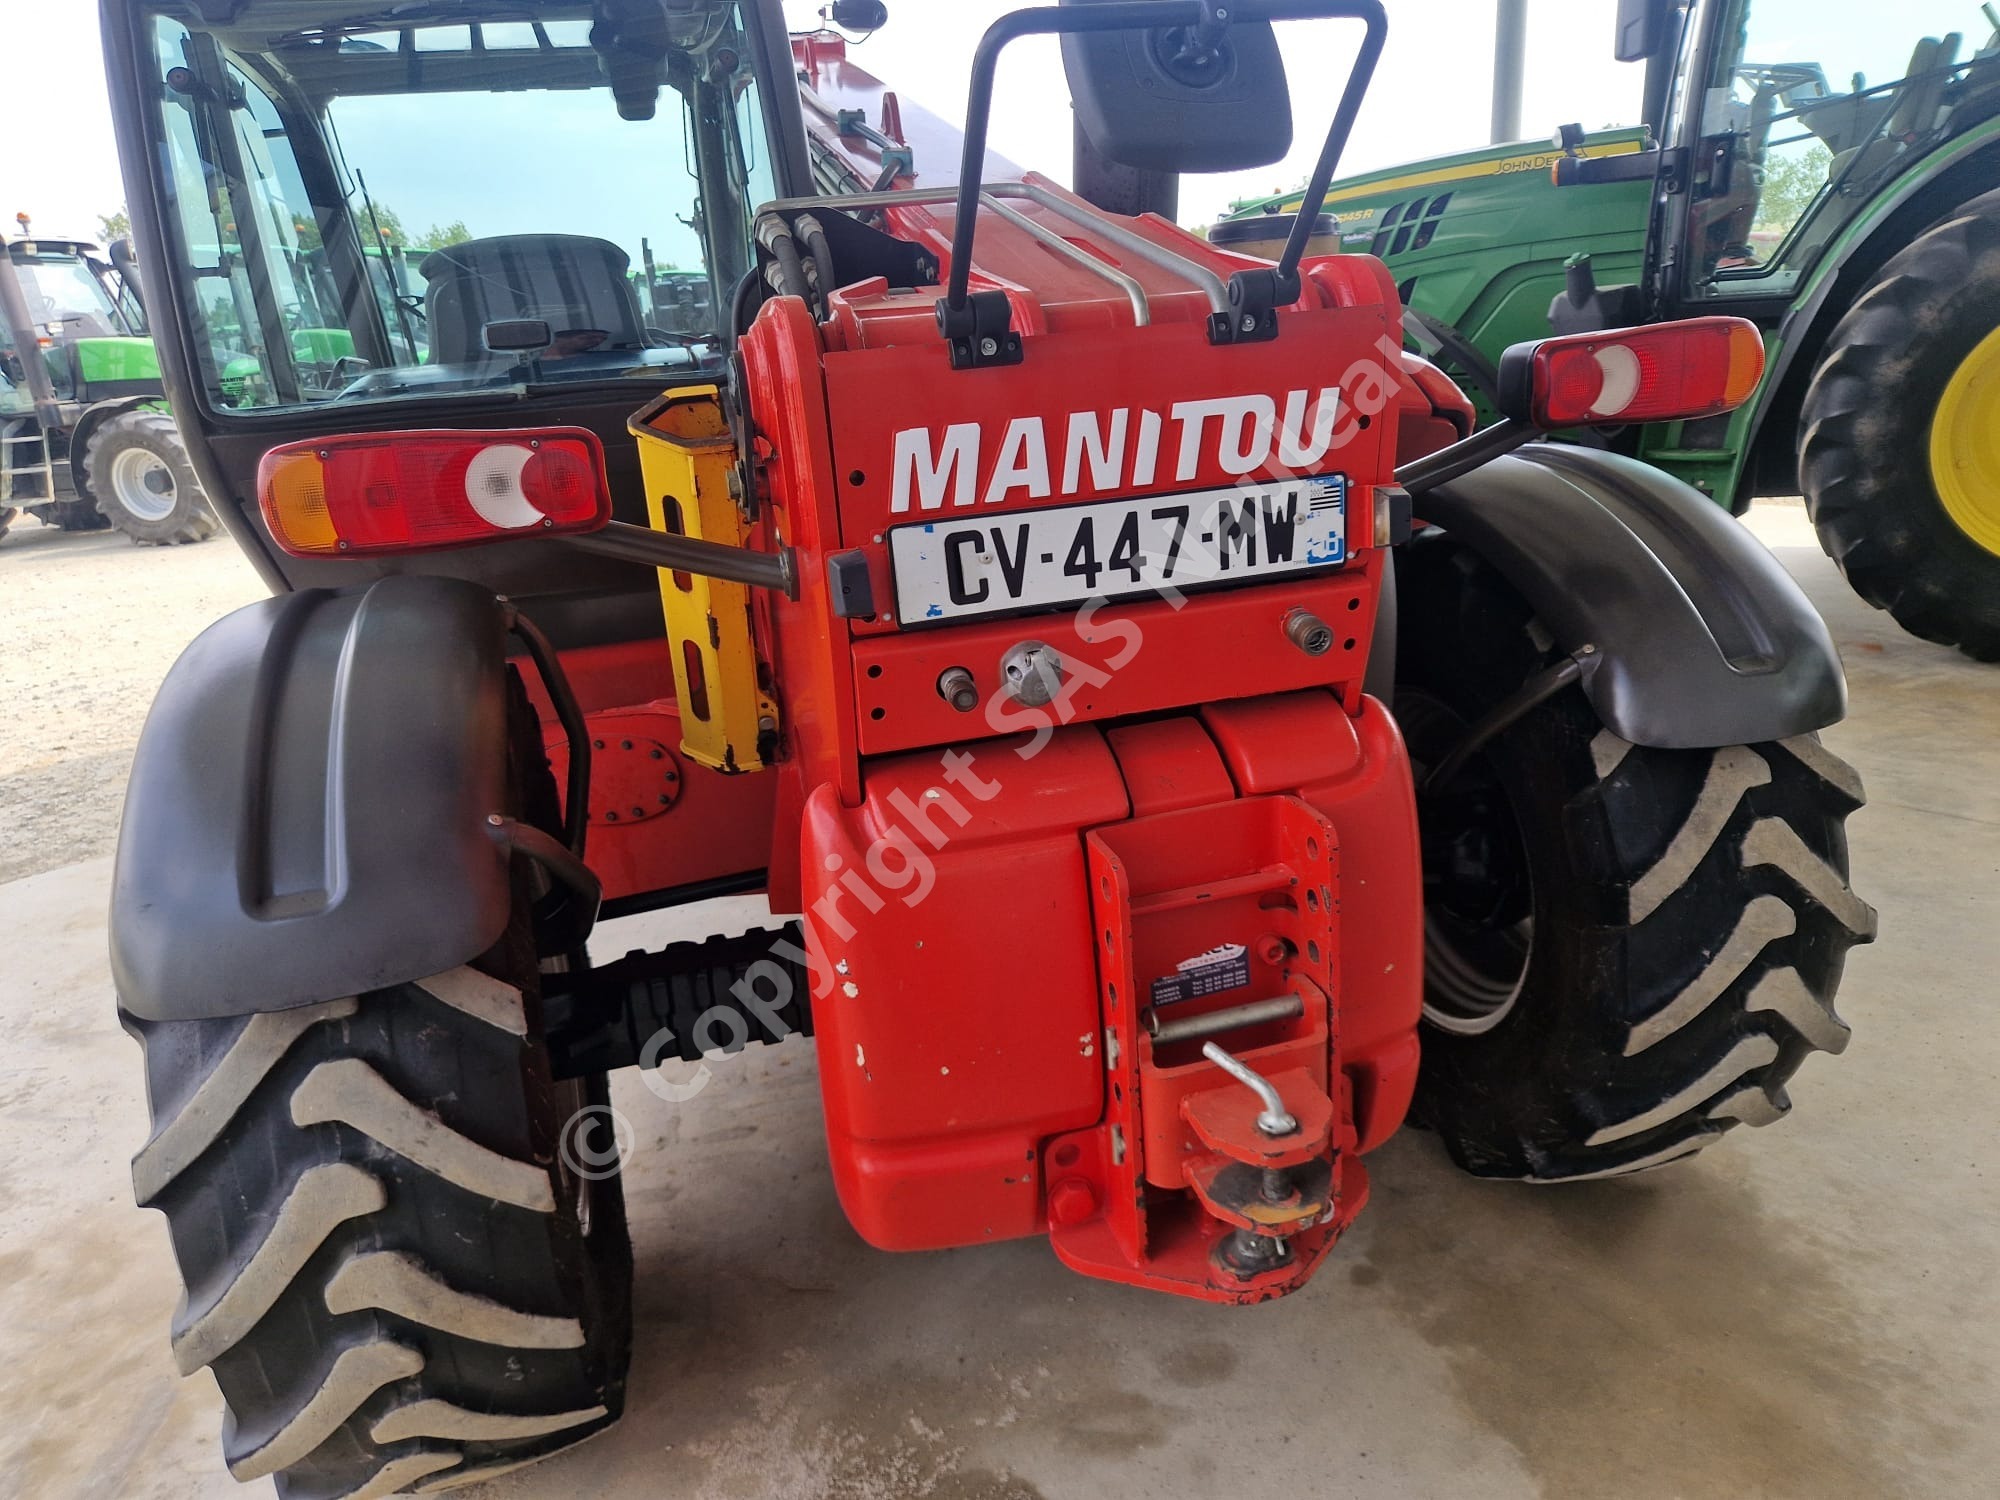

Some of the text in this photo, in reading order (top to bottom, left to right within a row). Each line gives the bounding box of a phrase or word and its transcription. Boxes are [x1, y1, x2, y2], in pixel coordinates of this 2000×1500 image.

[1495, 159, 1533, 174] JOHN
[890, 386, 1341, 514] MANITOU
[944, 491, 1298, 606] CV-447-MW
